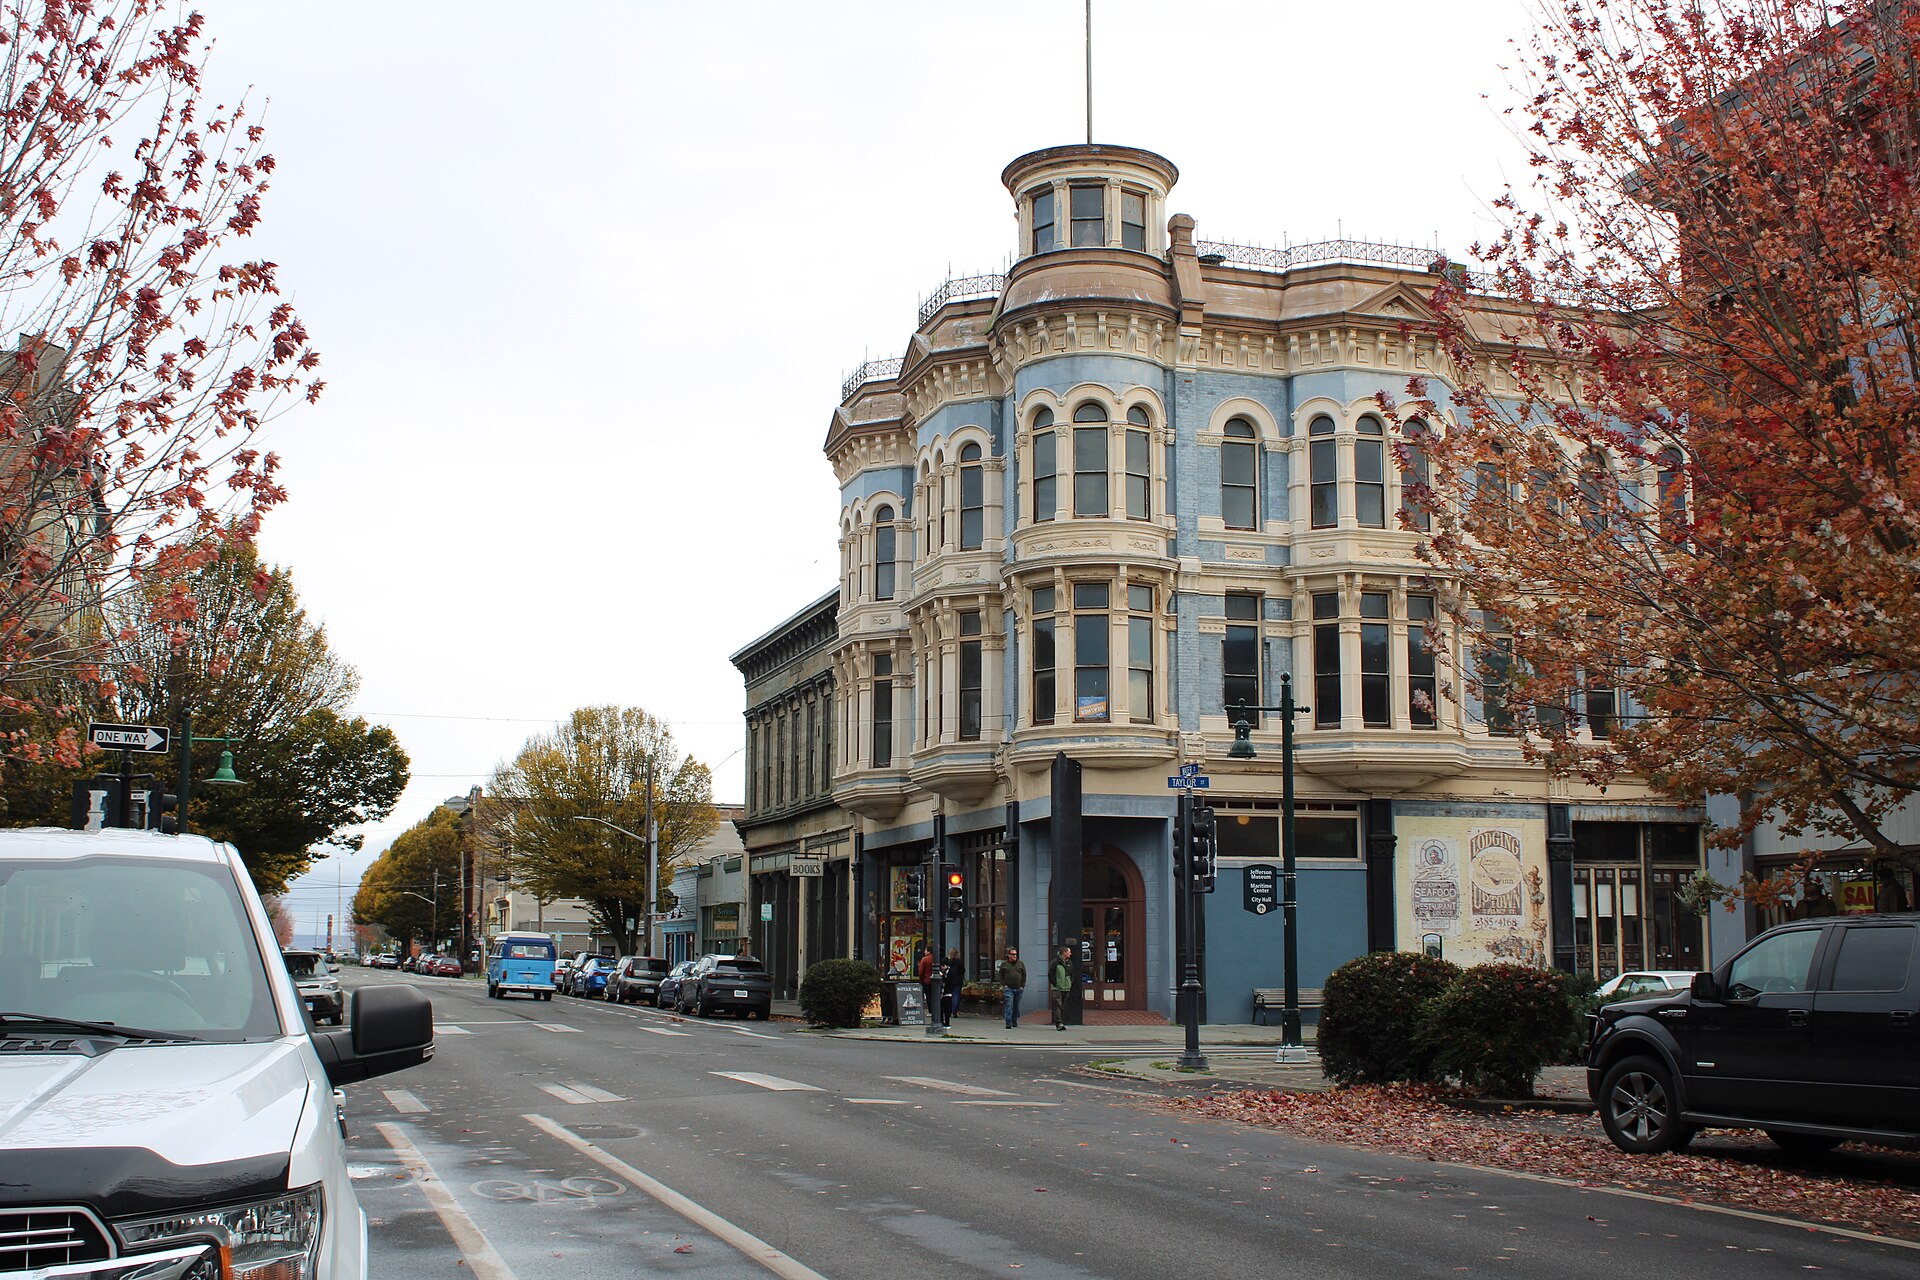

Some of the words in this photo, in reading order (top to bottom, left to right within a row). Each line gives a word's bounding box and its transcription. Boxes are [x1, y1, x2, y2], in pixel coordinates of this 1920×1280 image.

[97, 731, 120, 742] ONE
[124, 733, 149, 744] WAY
[1171, 778, 1197, 787] TAYLOR
[1471, 831, 1520, 857] LODGING
[792, 864, 821, 874] BOOKS
[1414, 888, 1457, 898] SEAFOOD
[1472, 883, 1521, 910] UPTOWN
[1844, 886, 1875, 906] SAL
[1251, 896, 1261, 904] City
